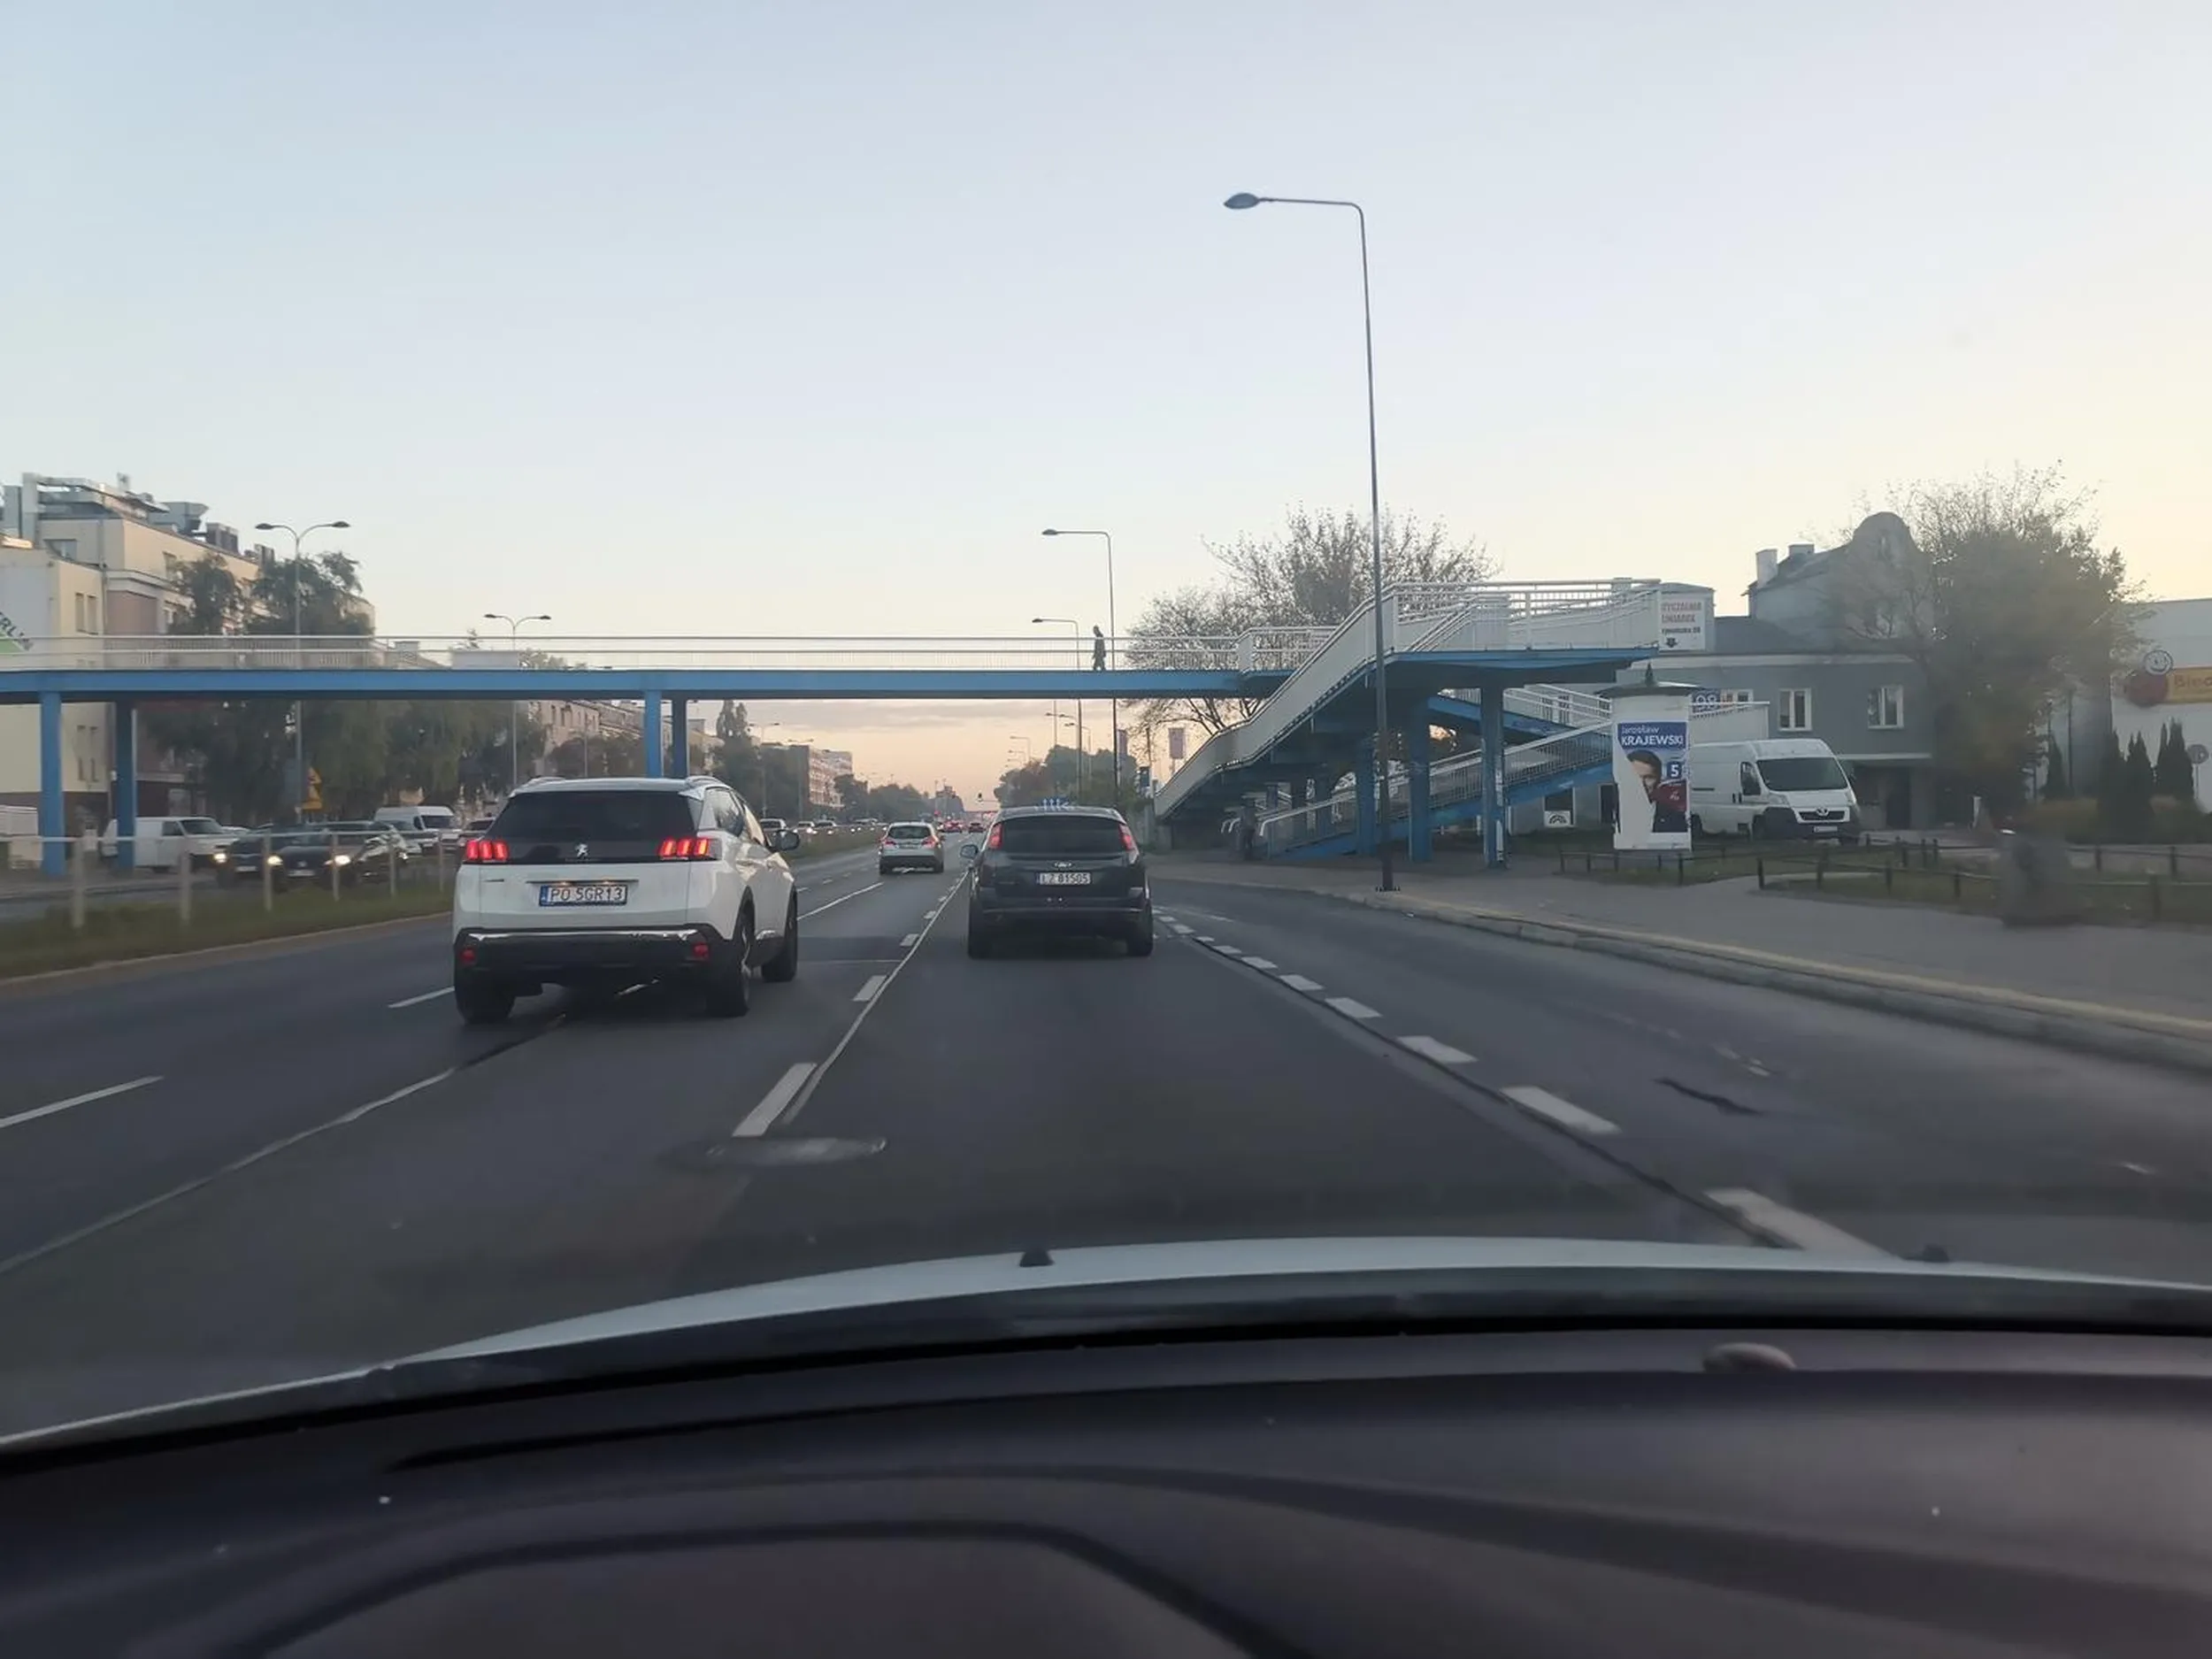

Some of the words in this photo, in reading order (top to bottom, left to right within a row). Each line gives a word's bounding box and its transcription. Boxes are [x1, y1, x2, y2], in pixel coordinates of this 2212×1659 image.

[1621, 734, 1684, 746] KRAJEWSKI
[1671, 764, 1679, 777] 5
[551, 888, 570, 901] PO
